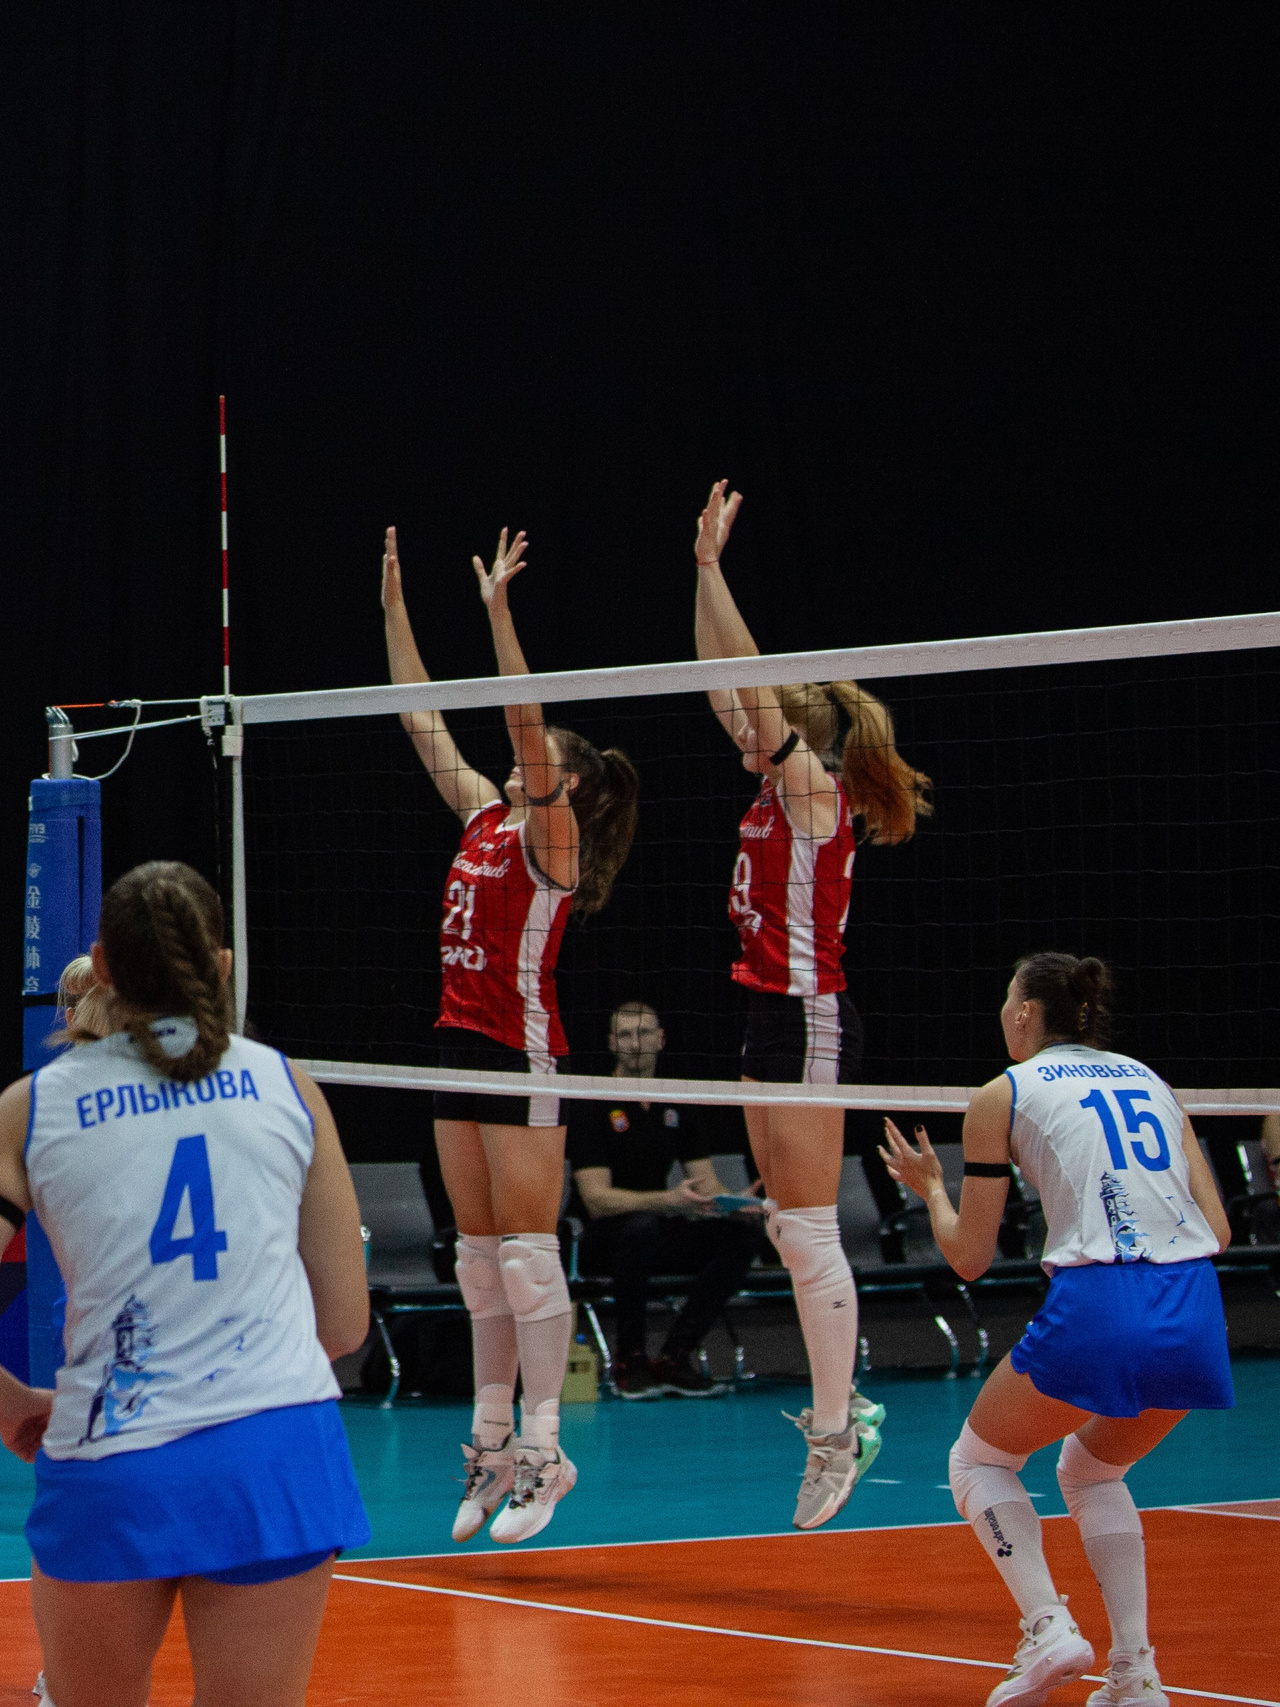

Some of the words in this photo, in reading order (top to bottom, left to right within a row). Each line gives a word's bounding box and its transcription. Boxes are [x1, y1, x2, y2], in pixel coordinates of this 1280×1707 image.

[442, 880, 476, 940] 21
[76, 1069, 260, 1129] ЕРЛЫКОВА
[1078, 1089, 1170, 1171] 15
[149, 1133, 228, 1282] 4
